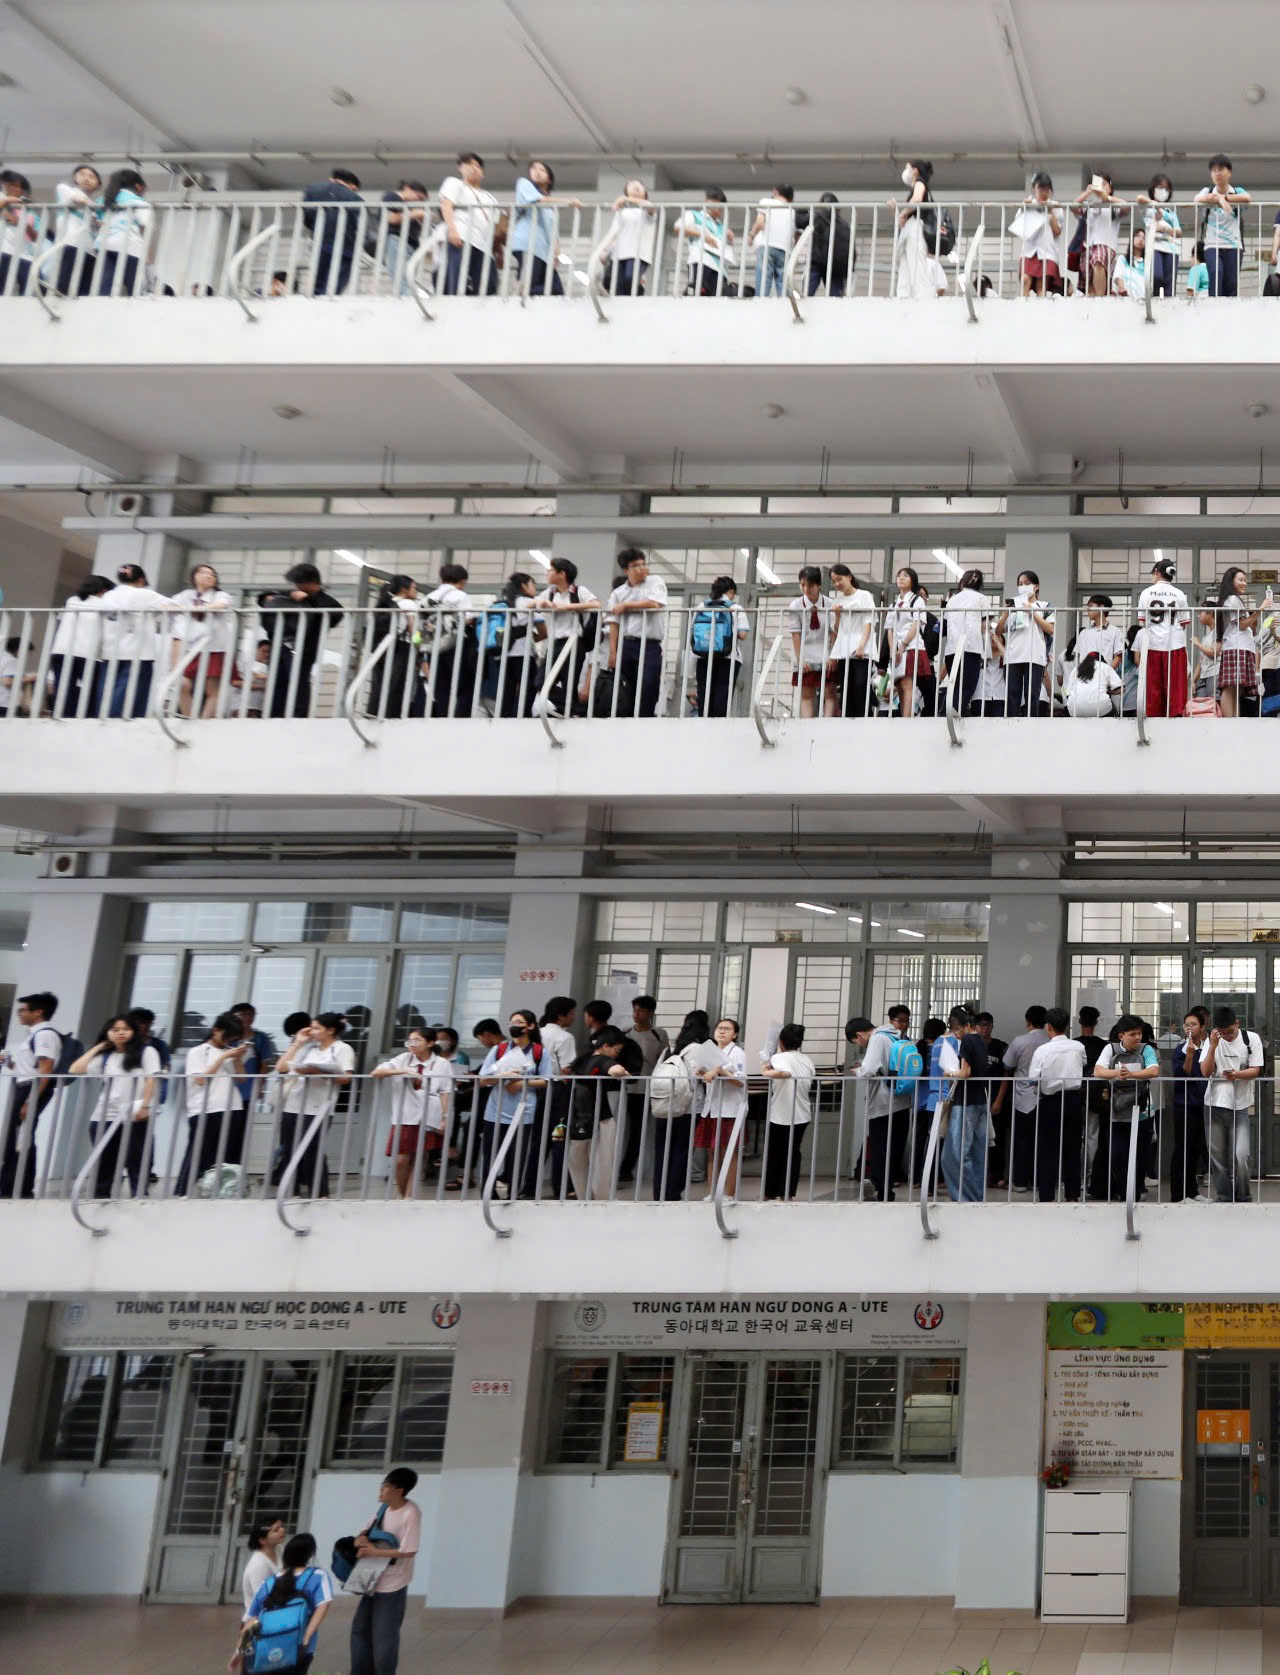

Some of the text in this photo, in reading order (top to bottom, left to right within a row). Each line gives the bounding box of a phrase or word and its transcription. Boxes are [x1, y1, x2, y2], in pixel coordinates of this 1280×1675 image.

[1150, 600, 1176, 625] 91
[116, 1302, 164, 1314] TRUNG
[379, 1302, 407, 1314] UTE
[632, 1302, 682, 1314] TRUNG
[862, 1302, 888, 1312] UTE
[168, 1319, 350, 1330] 동아대학교 한국어 교육센터
[664, 1318, 853, 1333] 동아대학교 한국어 교육센터
